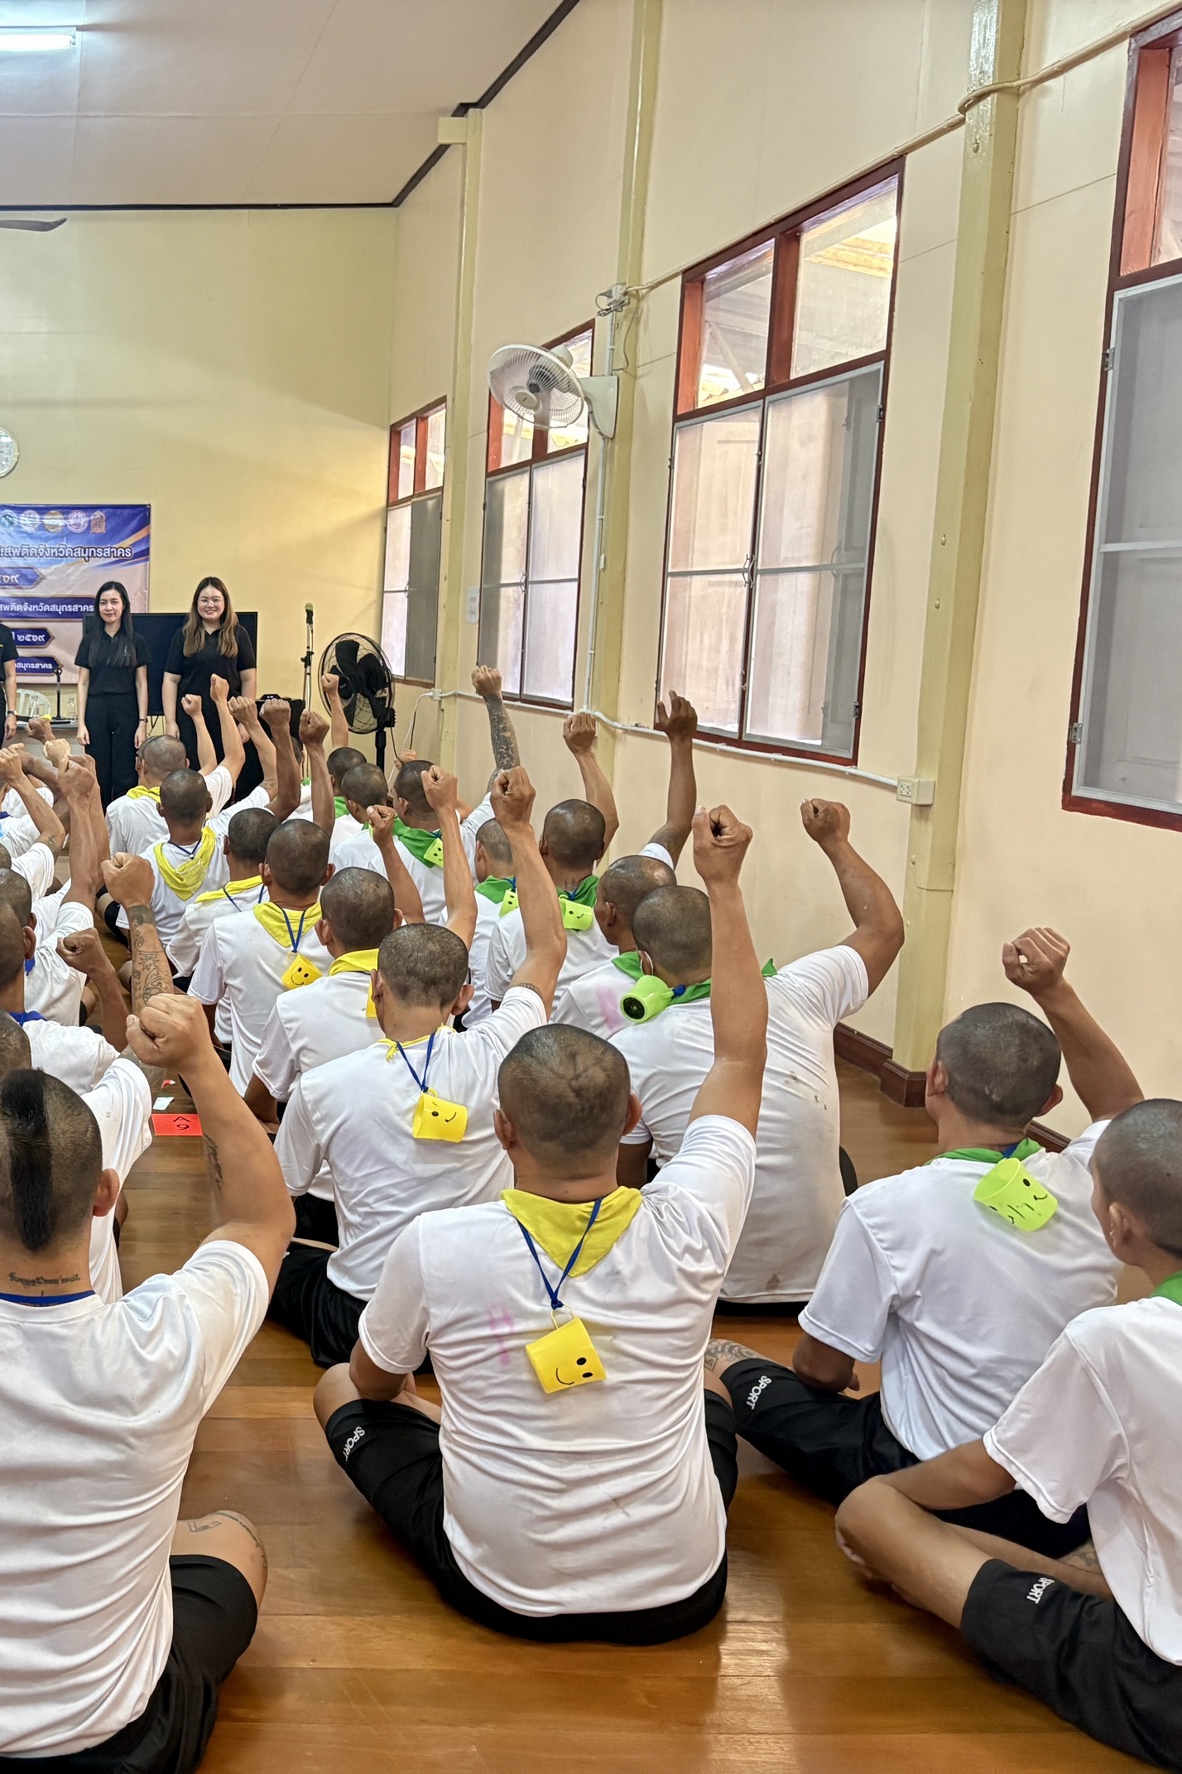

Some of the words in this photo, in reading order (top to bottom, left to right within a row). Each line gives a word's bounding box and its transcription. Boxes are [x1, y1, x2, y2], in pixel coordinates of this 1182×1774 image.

[745, 1375, 773, 1410] SPORT
[342, 1425, 366, 1462] SPORT
[1026, 1576, 1055, 1605] SPORT
